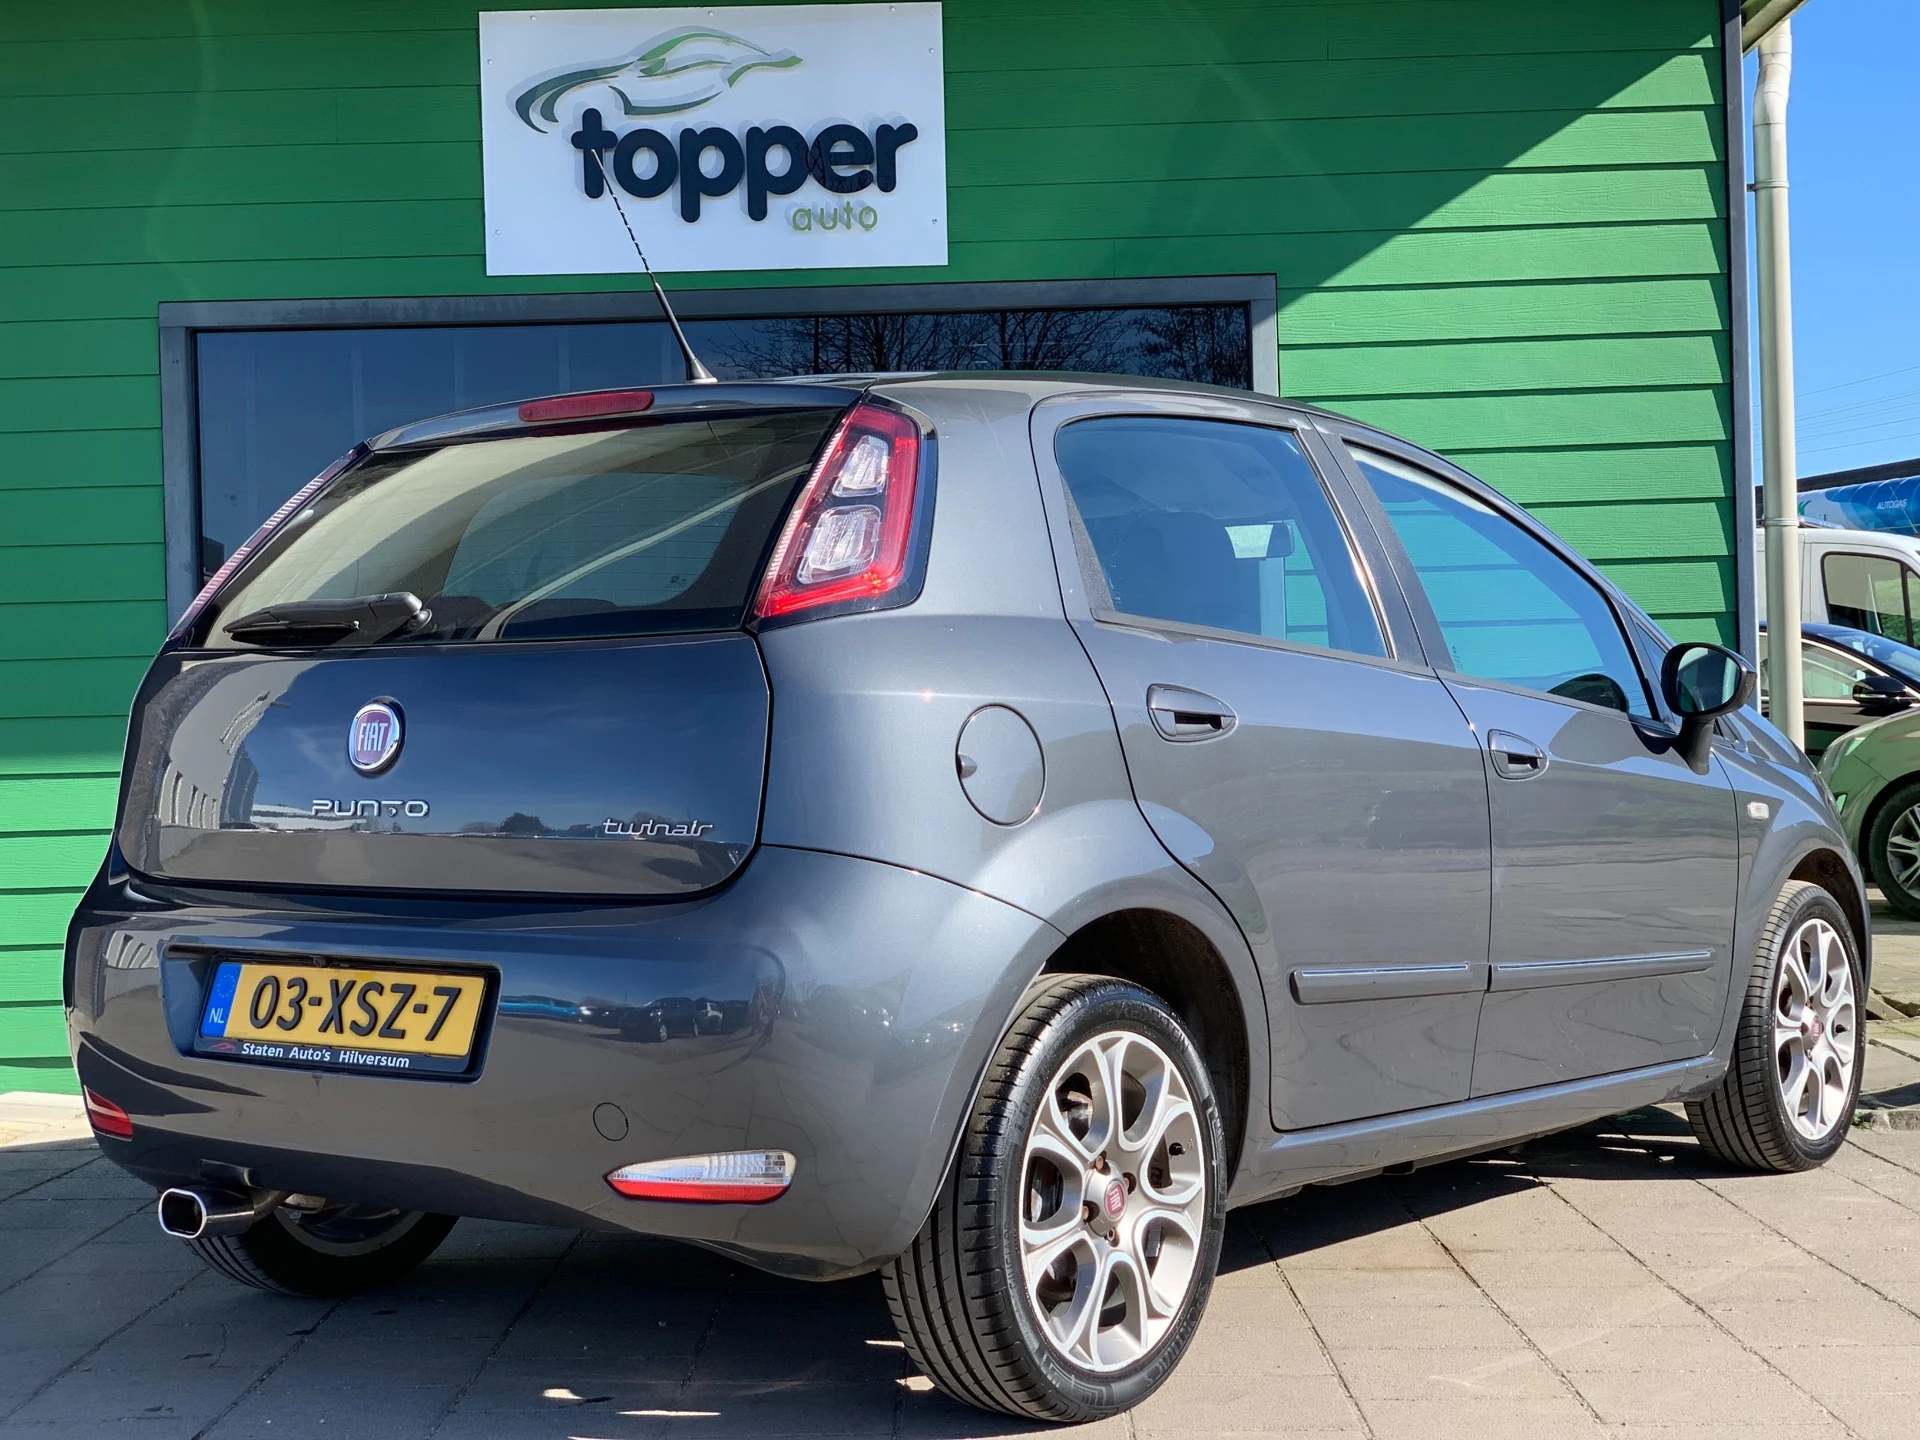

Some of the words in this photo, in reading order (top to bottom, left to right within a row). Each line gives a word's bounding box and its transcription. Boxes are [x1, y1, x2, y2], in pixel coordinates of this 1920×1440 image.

[571, 107, 918, 223] topper
[792, 201, 878, 231] auto
[1877, 498, 1907, 510] AUTOGAS
[357, 721, 389, 751] FIAT
[311, 799, 430, 818] PUNTO
[602, 818, 714, 838] twinair
[208, 1007, 225, 1024] NL
[249, 975, 462, 1041] 03-XSZ-7
[241, 1042, 284, 1059] Staten
[288, 1046, 331, 1062] Auto's
[339, 1050, 410, 1068] Hilversum
[1109, 1187, 1121, 1211] FIAT
